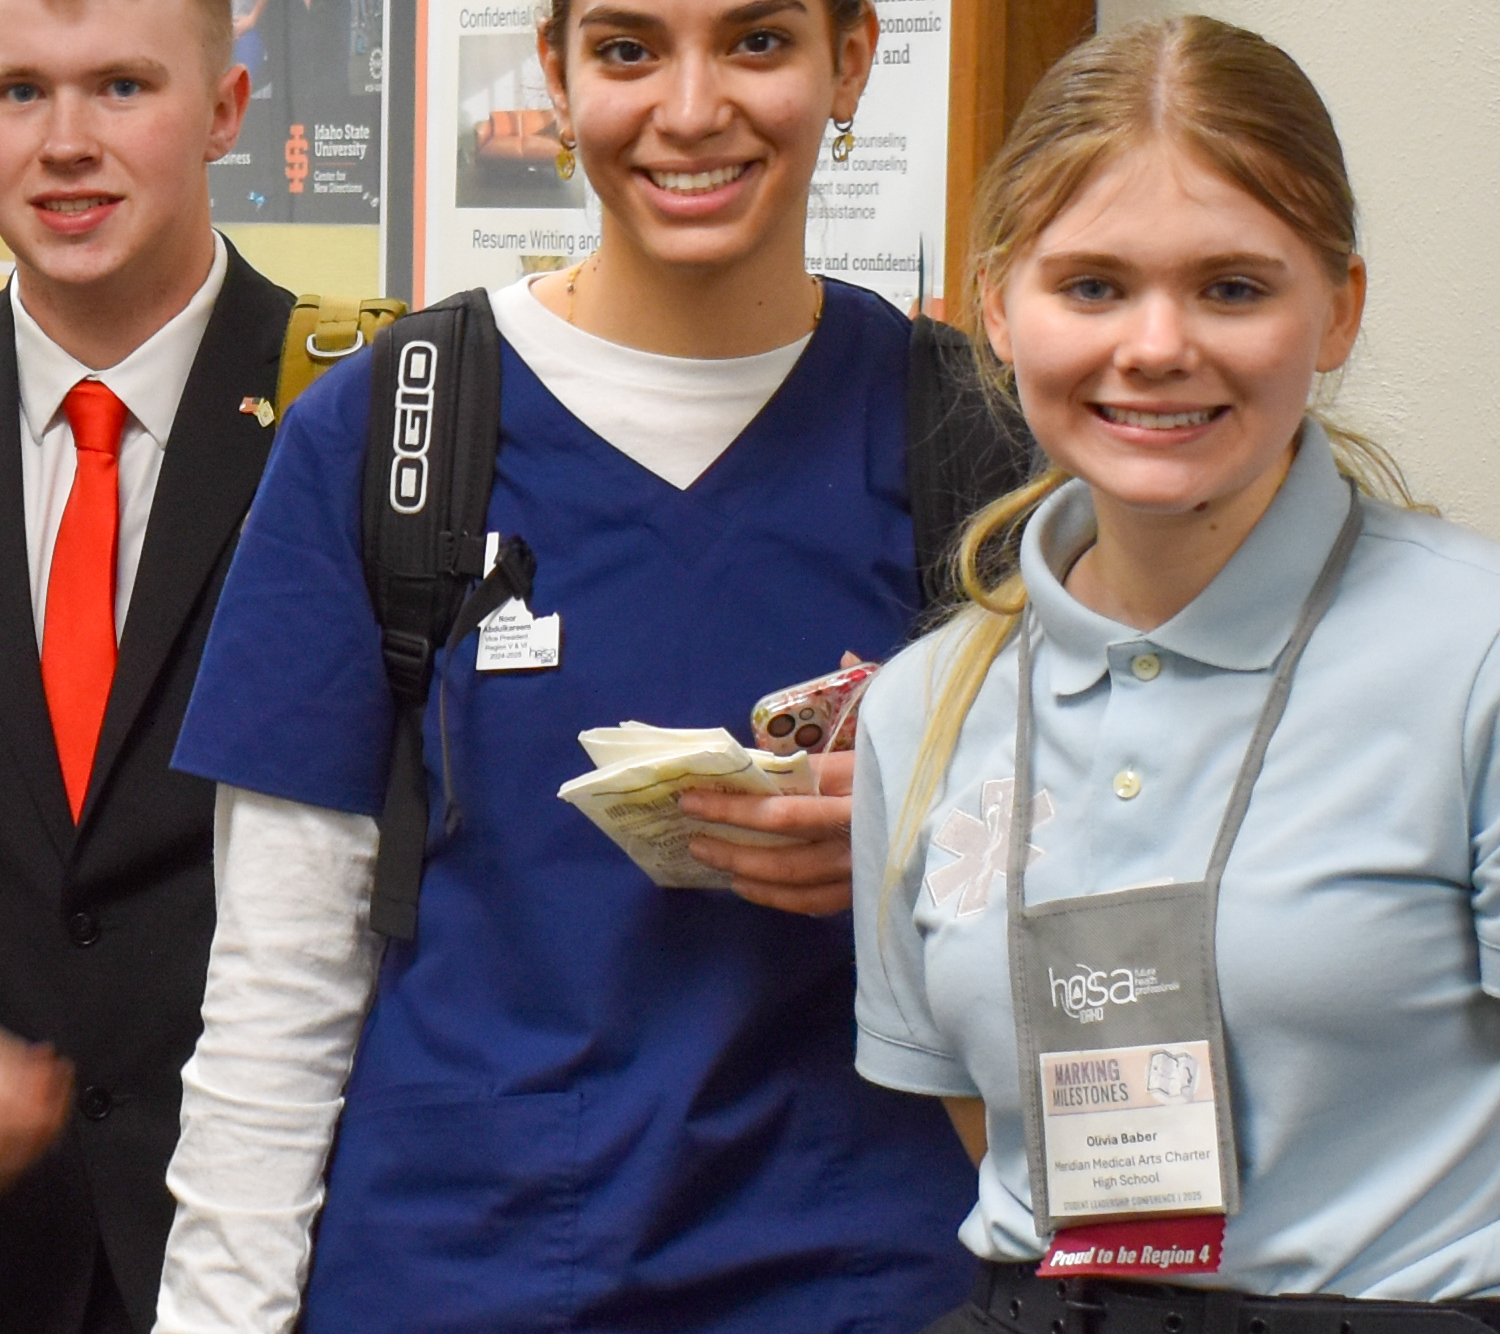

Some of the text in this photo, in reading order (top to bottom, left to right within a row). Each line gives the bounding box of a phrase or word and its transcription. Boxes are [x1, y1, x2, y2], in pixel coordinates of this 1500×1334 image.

[459, 6, 532, 29] Confidential
[879, 11, 942, 33] conomic
[314, 123, 370, 140] Idaho State
[314, 142, 368, 160] University
[472, 229, 575, 254] Resume Writing
[390, 340, 438, 514] OGIO
[1048, 966, 1138, 1010] hosa
[1055, 1058, 1121, 1086] MARKING
[1052, 1082, 1129, 1107] MILESTONES
[1086, 1132, 1158, 1147] Olivia Baber
[1092, 1149, 1211, 1171] Medical Charter
[1050, 1245, 1195, 1269] Proud Region
